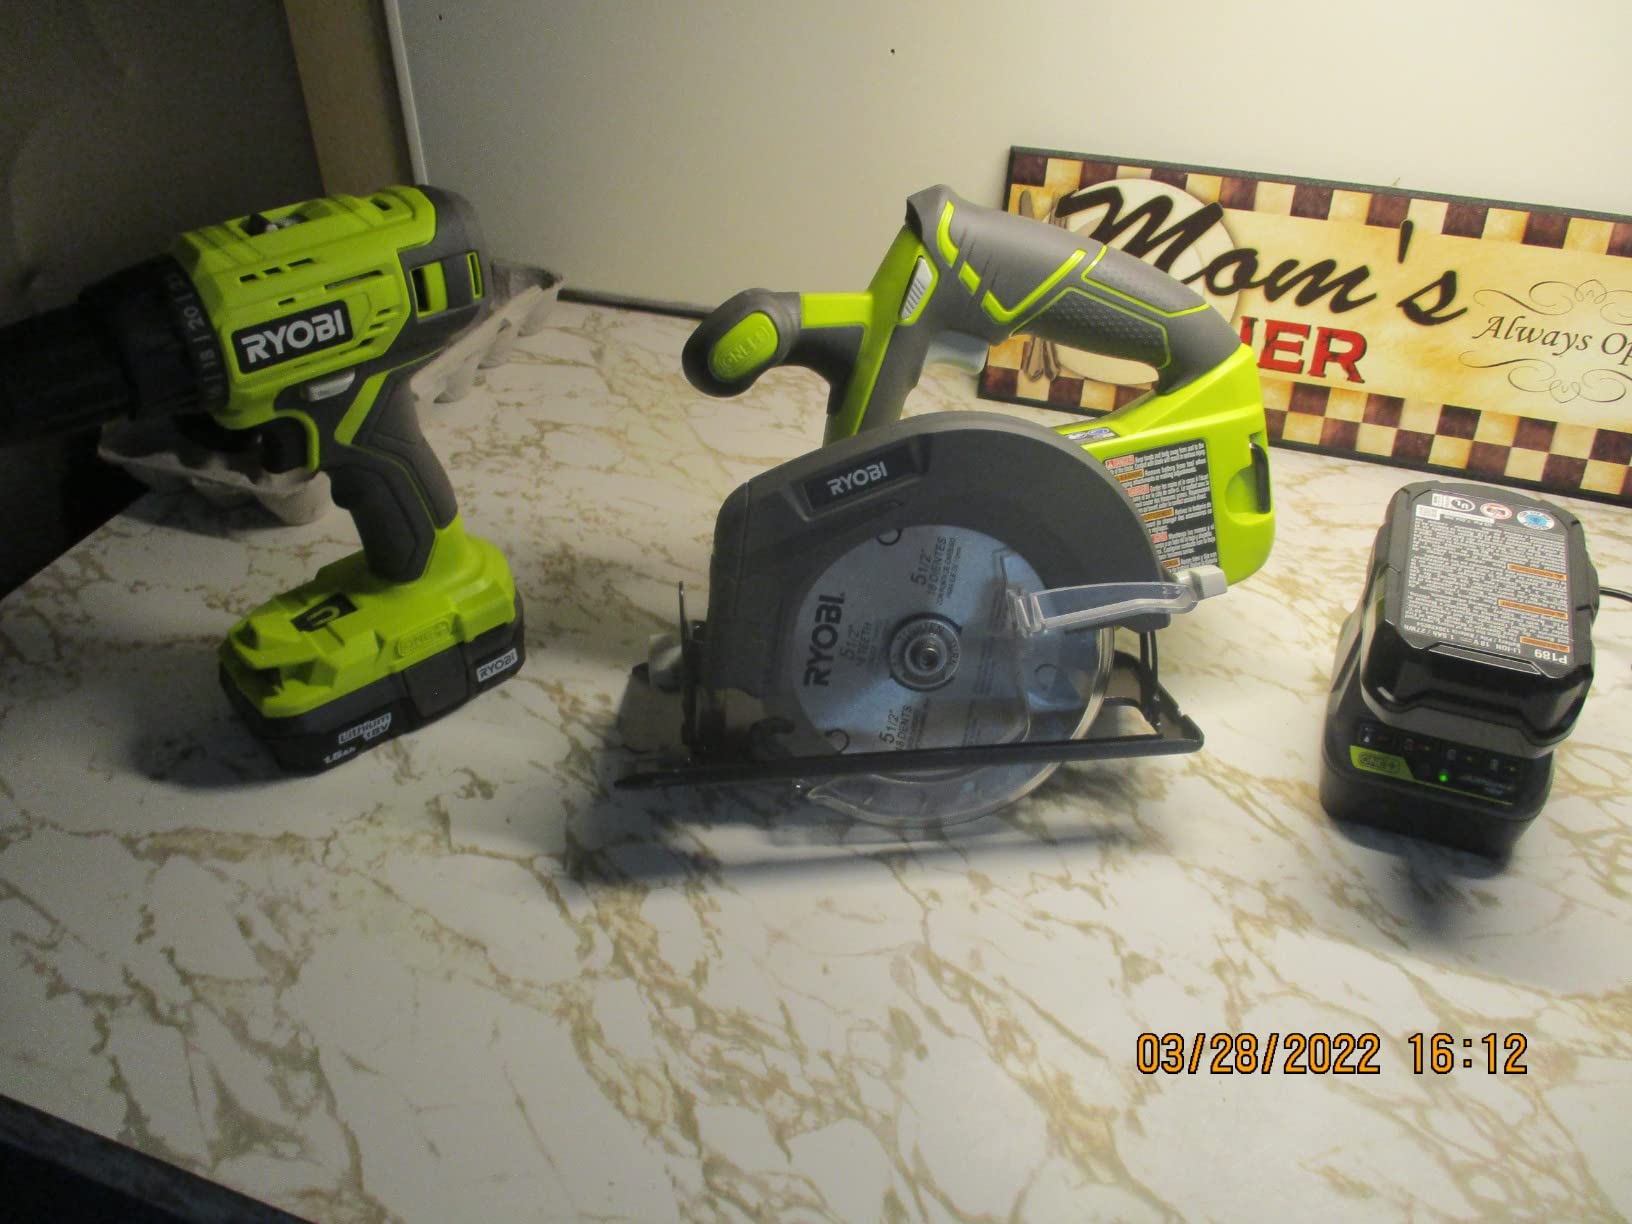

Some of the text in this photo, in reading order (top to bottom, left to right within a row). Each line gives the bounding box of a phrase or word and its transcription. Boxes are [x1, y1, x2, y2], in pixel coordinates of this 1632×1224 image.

[1055, 185, 1469, 326] Mom's
[241, 308, 346, 364] RYOBI
[1472, 315, 1594, 355] Always
[827, 461, 888, 496] RYOBI
[804, 594, 844, 687] RYOBI
[1534, 649, 1568, 665] P189
[479, 651, 516, 681] RYOBI
